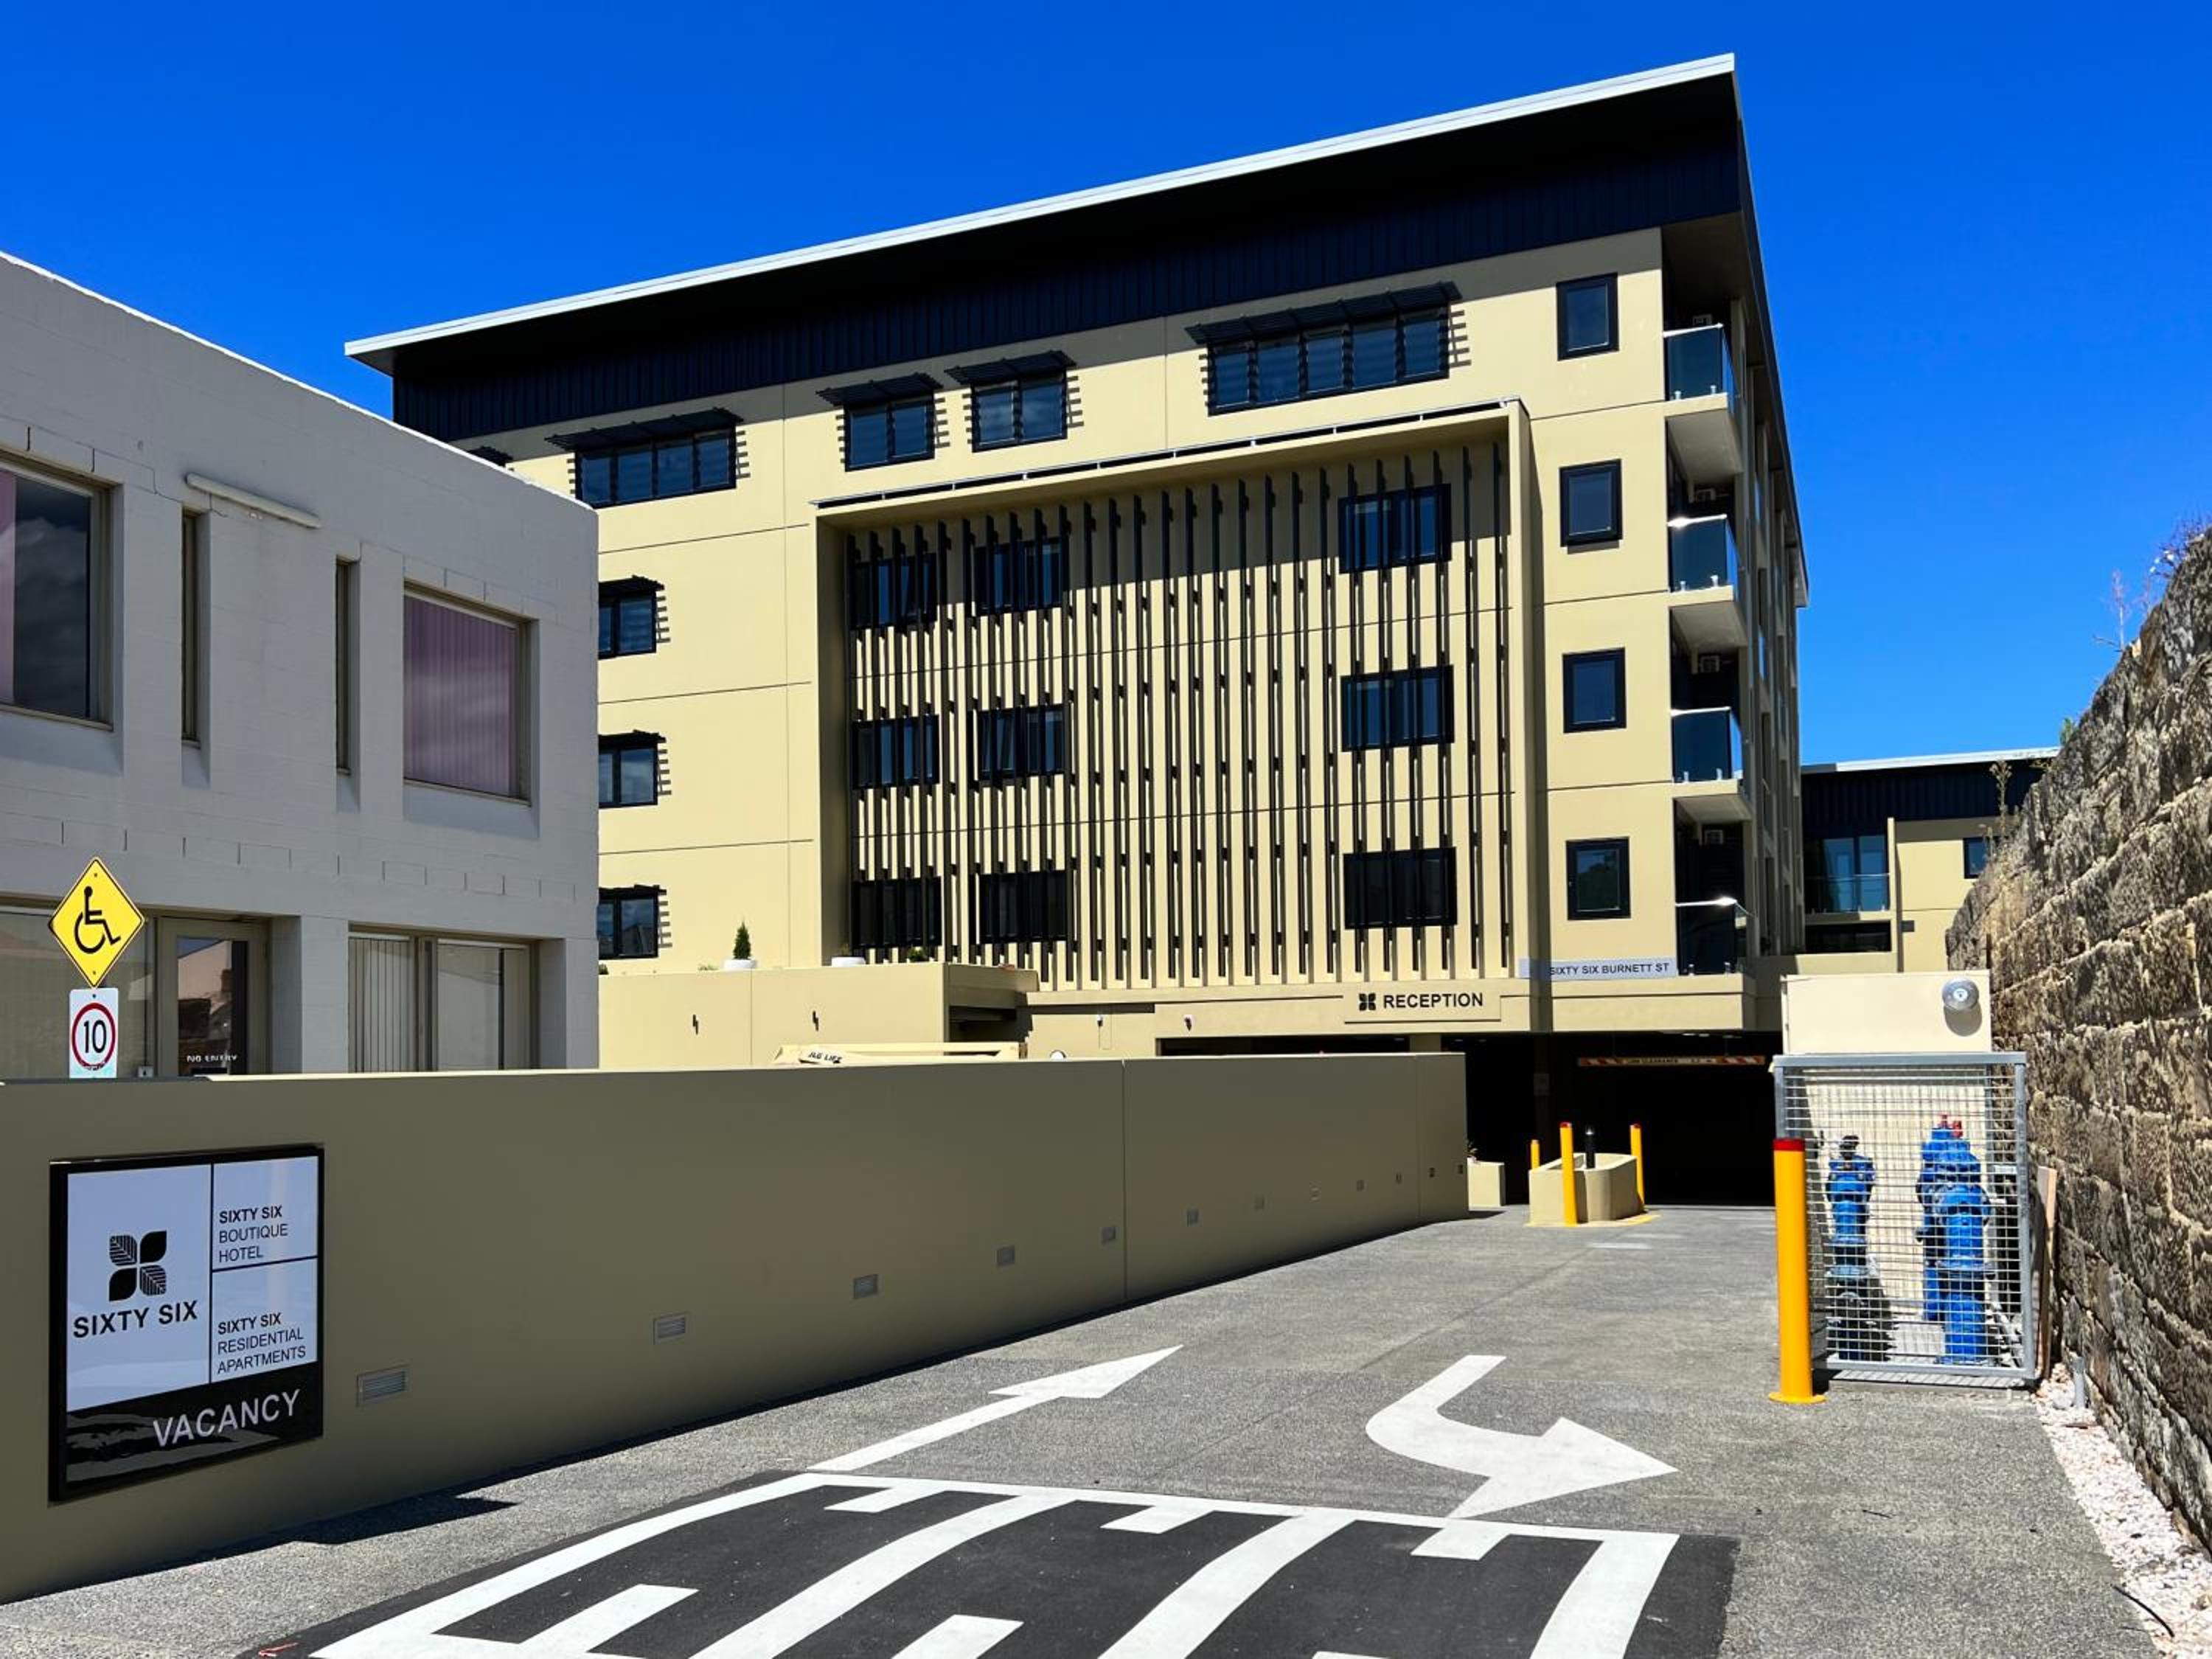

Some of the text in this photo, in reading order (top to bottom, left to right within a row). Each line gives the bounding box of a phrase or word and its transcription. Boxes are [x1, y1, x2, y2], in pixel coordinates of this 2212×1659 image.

[1549, 963, 1669, 975] SIXTY SIX BURNETT ST
[1383, 992, 1483, 1009] RECEPTION
[83, 1020, 107, 1053] 10
[219, 1206, 282, 1223] SIXTY SIX
[219, 1223, 288, 1243] BOUTIQUE
[219, 1246, 263, 1262] HOTEL
[73, 1300, 198, 1338] SIXTY SIX
[218, 1312, 282, 1335] SIXTY SIX
[218, 1327, 304, 1354] RESIDENTIAL
[218, 1346, 307, 1374] APARTMENTS
[153, 1388, 300, 1447] VACANCY
